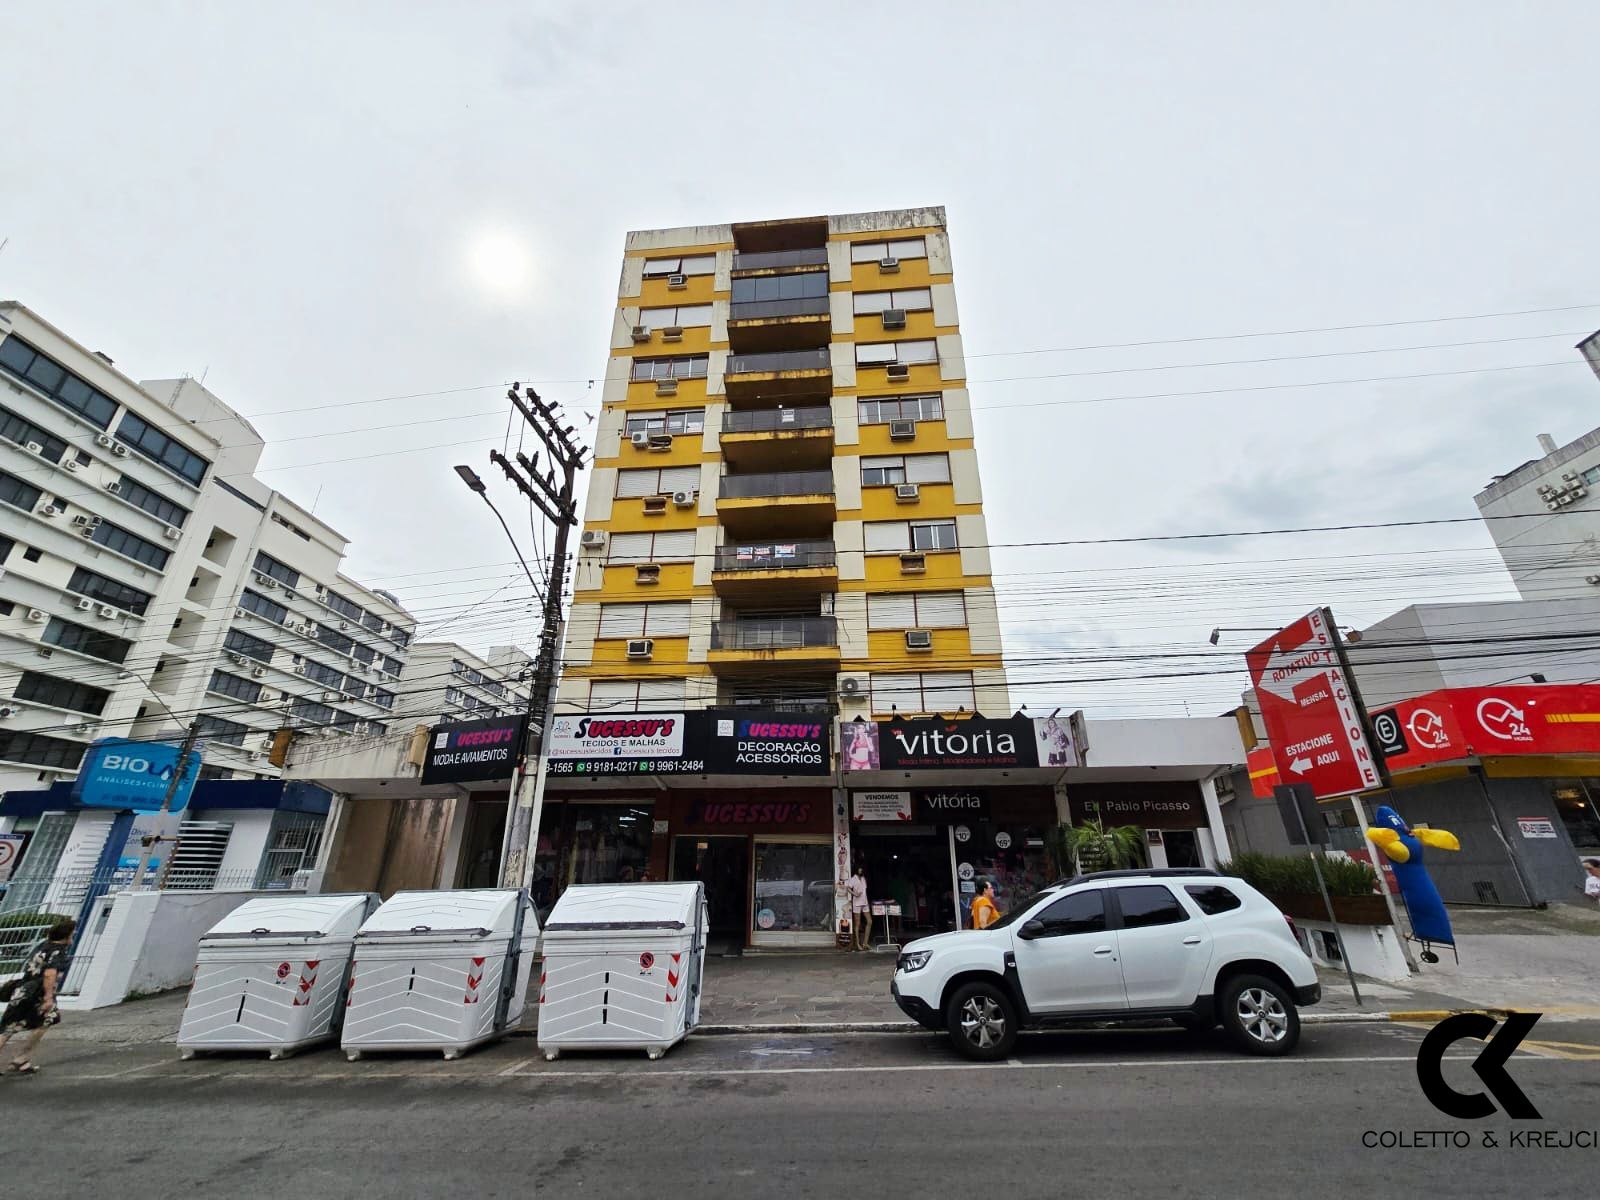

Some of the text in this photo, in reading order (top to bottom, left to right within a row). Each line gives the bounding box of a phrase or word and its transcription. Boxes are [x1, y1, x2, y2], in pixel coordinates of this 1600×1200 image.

[1272, 651, 1320, 682] ROTATIVO
[1300, 690, 1329, 707] MENSAL
[1311, 615, 1375, 783] ESTACIONE
[575, 718, 675, 739] SUCESSU'S
[1432, 729, 1449, 743] 24
[1508, 723, 1531, 735] 24
[582, 740, 619, 748] TECIDOS
[630, 738, 666, 747] MALHAS
[738, 741, 821, 754] DECORAÇÃO
[1286, 733, 1334, 757] ESTACIONE
[432, 748, 508, 767] MODA E AVIAMENTOS
[736, 753, 822, 764] ACESSÓRIOS
[1317, 750, 1340, 766] AQUI
[586, 762, 592, 772] 9
[594, 761, 638, 772] 9181-0217
[649, 761, 655, 771] 9
[657, 760, 704, 771] 9961-2484
[927, 794, 981, 809] vitória
[1107, 801, 1140, 811] Pablo
[1143, 801, 1190, 811] Picasso
